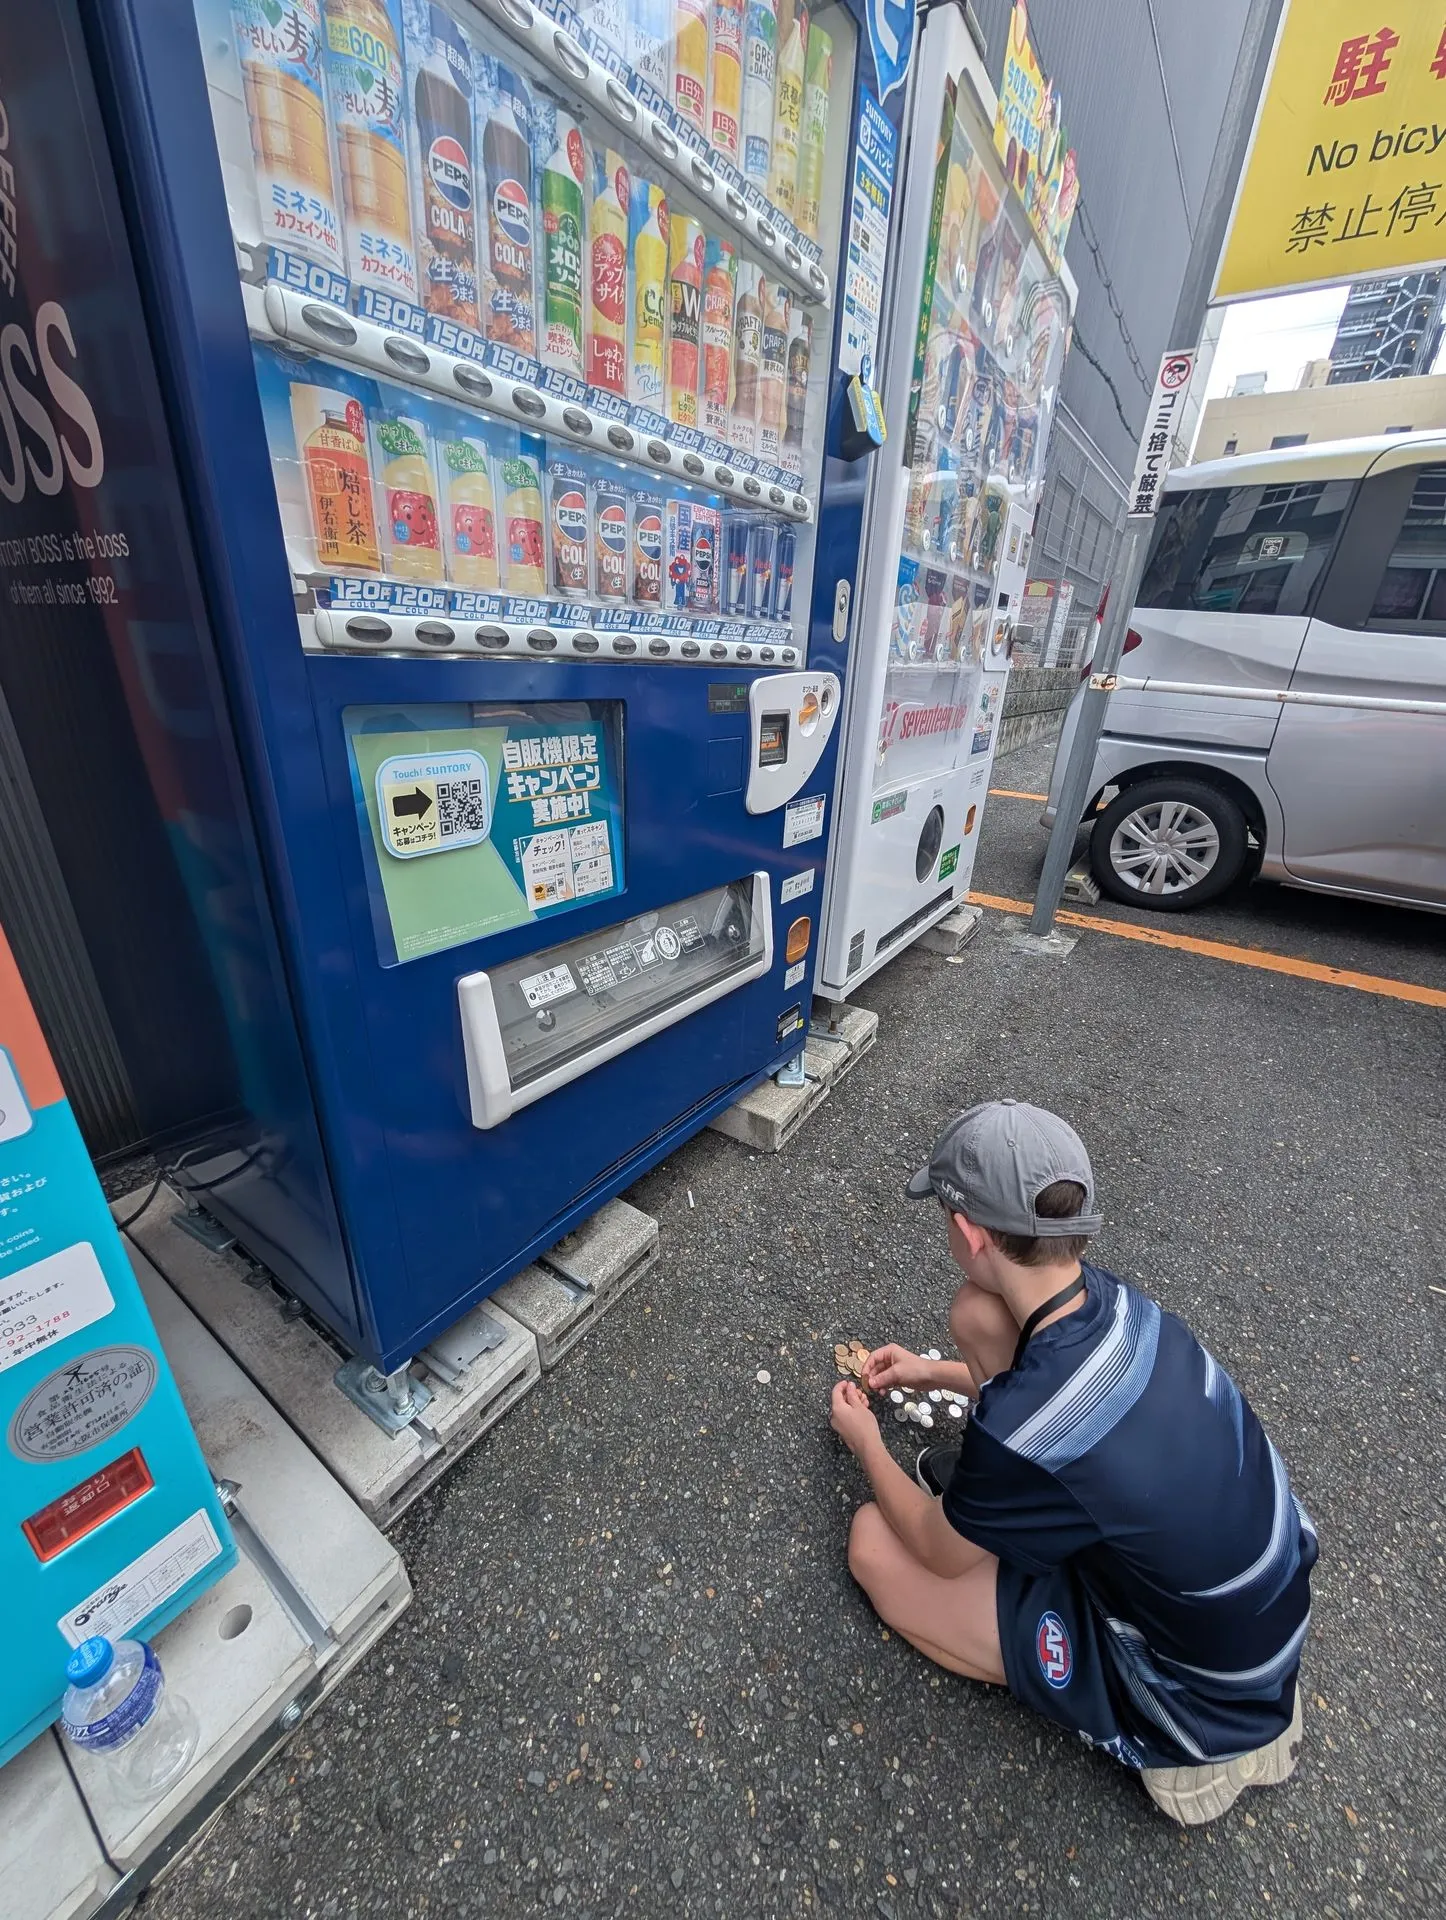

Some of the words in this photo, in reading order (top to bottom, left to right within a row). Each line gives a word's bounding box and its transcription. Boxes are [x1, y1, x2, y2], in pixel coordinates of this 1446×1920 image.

[350, 26, 387, 71] 600
[1306, 140, 1358, 176] No
[272, 184, 337, 235] ミネラル
[431, 205, 466, 239] COLA
[1285, 181, 1446, 254] 禁止停
[360, 232, 414, 272] ミネラル
[494, 242, 525, 272] COLA
[274, 249, 347, 303] 130円
[594, 263, 625, 283] アップ
[364, 289, 425, 334] 130円
[433, 318, 486, 362] 150円
[593, 339, 625, 363] しゅわ
[492, 345, 538, 381] 150円
[545, 368, 585, 402] 150円
[592, 388, 628, 418] 150円
[633, 407, 667, 435] 150円
[670, 423, 702, 447] 150円
[701, 438, 730, 460] 150円
[729, 447, 756, 471] 160円
[1133, 390, 1180, 514] ゴミ捨て厳禁
[756, 460, 779, 481] 160円
[338, 466, 367, 546] 焙じ茶
[319, 496, 340, 556] 伊右衛門
[27, 533, 63, 564] BOSS
[60, 533, 75, 560] is
[73, 530, 96, 560] the
[93, 528, 130, 558] boss
[42, 578, 58, 605] all
[56, 578, 87, 605] since
[86, 576, 119, 605] 1992
[334, 578, 392, 601] 120円
[394, 586, 446, 609] 120円
[454, 592, 500, 614] 120円
[350, 601, 376, 609] COLD
[405, 606, 429, 615] COLD
[508, 598, 548, 618] 120円
[555, 603, 591, 621] 110円
[601, 609, 631, 624] 110円
[635, 613, 664, 628] 110円
[665, 617, 692, 631] 110円
[697, 621, 719, 633] 110円
[721, 624, 745, 636] 220円
[747, 626, 769, 637] 220円
[768, 628, 788, 640] 220円
[899, 702, 953, 740] seventeen
[501, 733, 599, 770] 自販機限定
[393, 768, 422, 780] Touch!
[425, 763, 472, 776] SUNTORY
[507, 765, 601, 799] キャンペーン
[531, 794, 590, 824] 実施中!
[392, 821, 436, 837] キャンペーン
[396, 832, 437, 847] 応募はコチラ!
[533, 840, 566, 857] チェック!
[6, 1228, 34, 1243] coins
[23, 1360, 147, 1442] 営業許可済の証
[73, 1408, 129, 1447] 大阪市保健所
[1045, 1616, 1066, 1680] AFL
